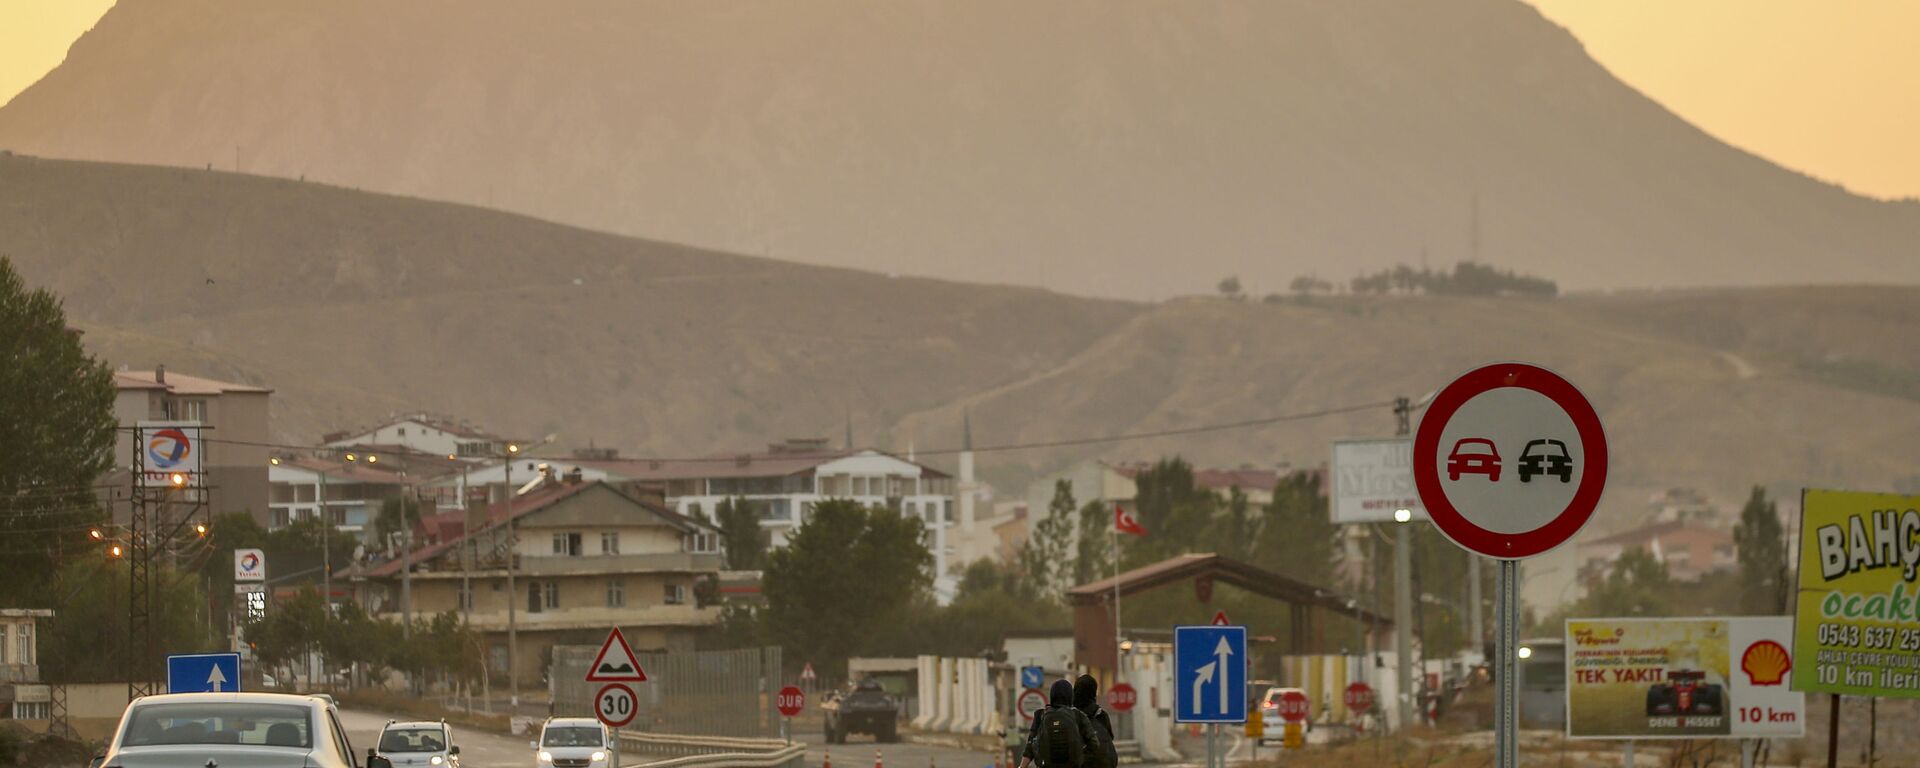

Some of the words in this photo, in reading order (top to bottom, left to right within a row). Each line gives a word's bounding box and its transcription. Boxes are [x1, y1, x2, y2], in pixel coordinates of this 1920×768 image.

[1819, 623, 1859, 647] 0543
[1865, 626, 1896, 649] 637
[1900, 629, 1920, 651] 25
[1818, 650, 1847, 662] AHLAT
[1850, 652, 1882, 667] ÇEVRE
[1885, 654, 1908, 668] YOLU
[1575, 669, 1606, 684] TEK
[1613, 668, 1664, 683] YAKIT
[1818, 664, 1838, 684] 10
[1845, 666, 1873, 687] km
[603, 694, 630, 715] 30
[778, 694, 803, 708] DUR
[1739, 706, 1763, 723] 10
[1767, 706, 1797, 722] km
